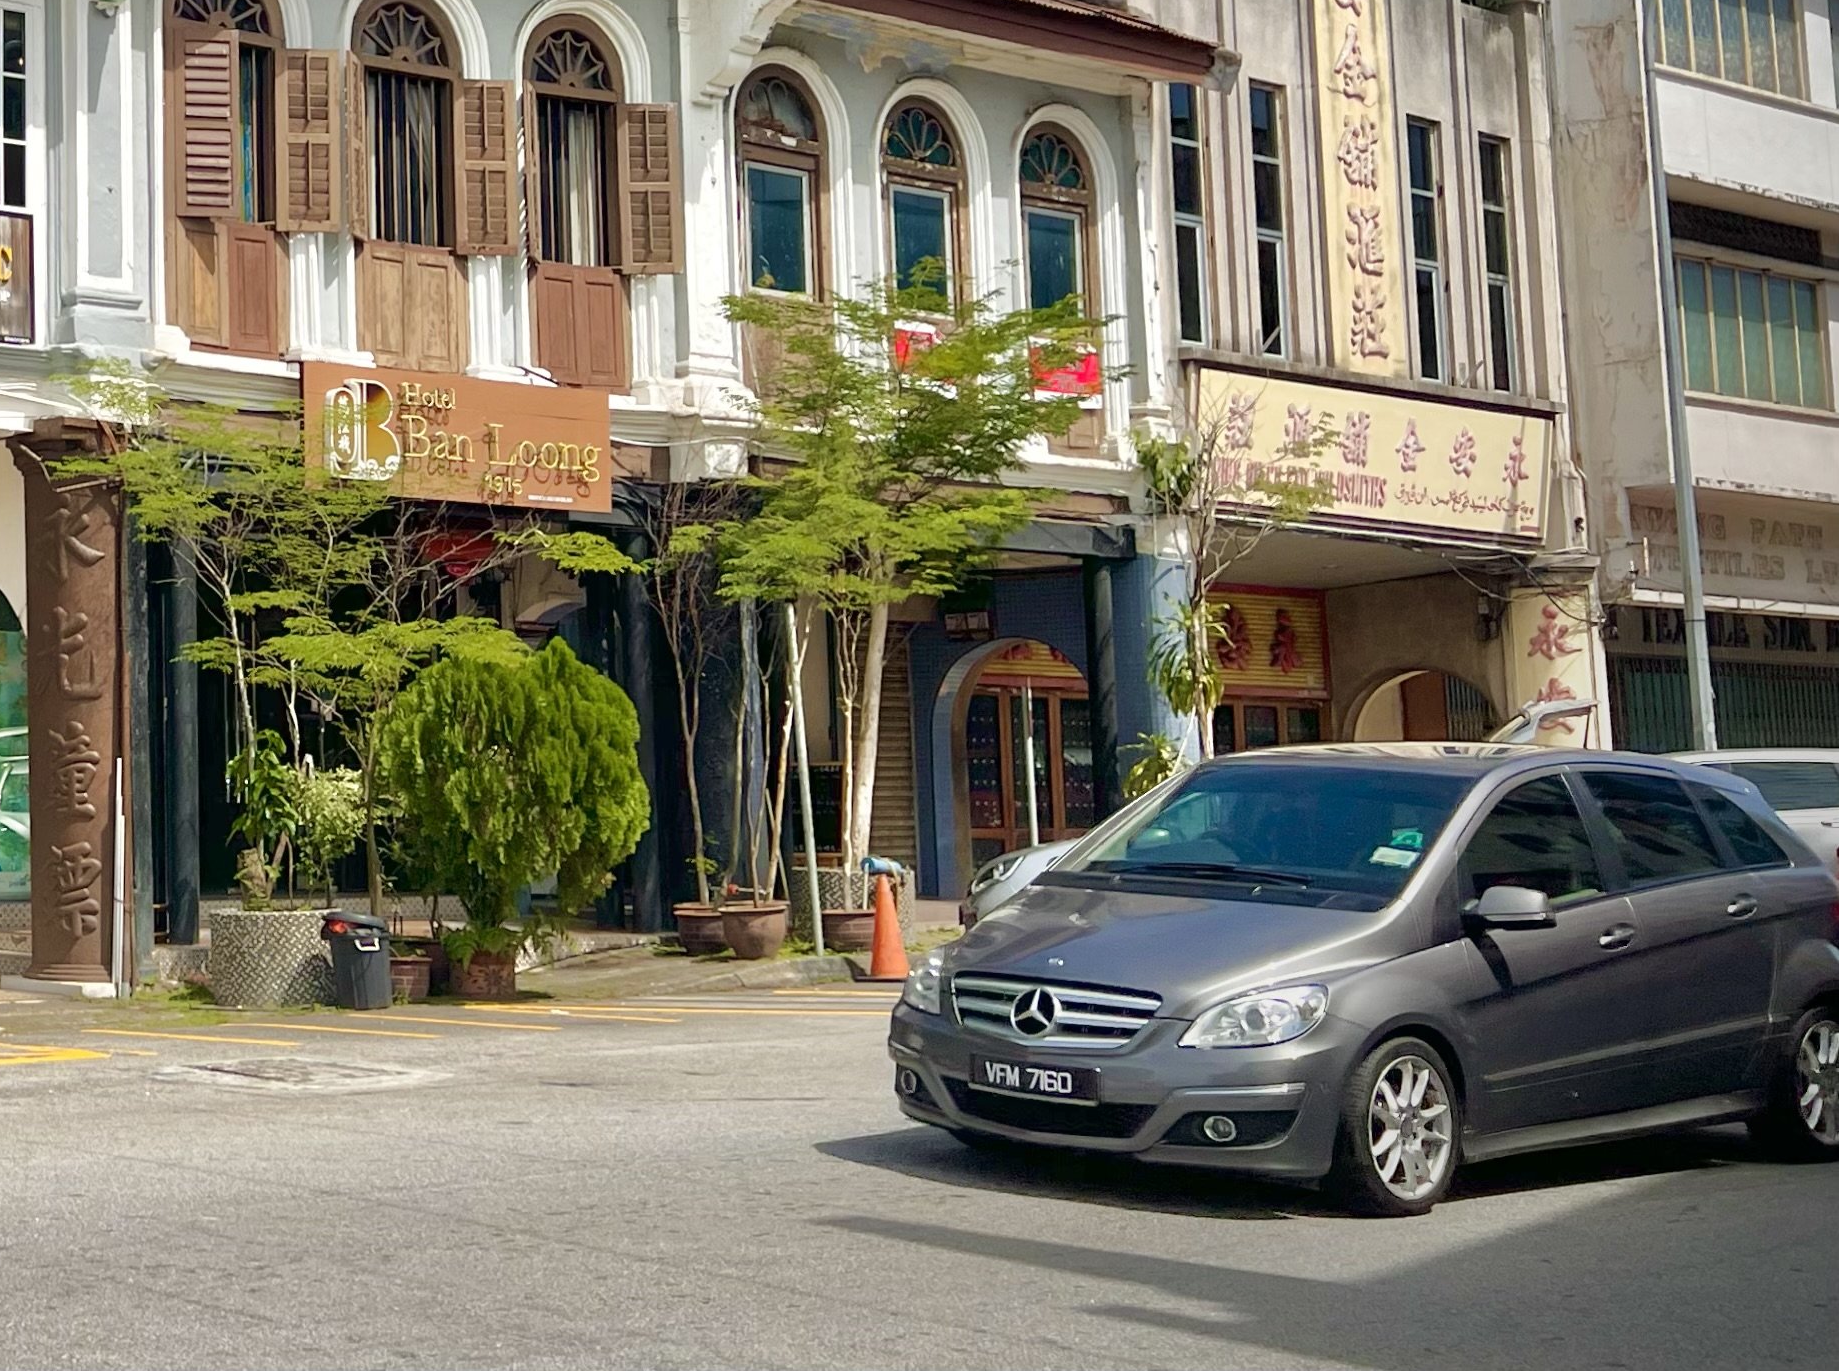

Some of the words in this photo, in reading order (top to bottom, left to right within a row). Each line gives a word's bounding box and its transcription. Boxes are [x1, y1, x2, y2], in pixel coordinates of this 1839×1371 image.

[401, 382, 456, 410] Hotel
[402, 415, 476, 463] Ban
[488, 423, 602, 482] Loong
[1647, 543, 1786, 581] TETILES
[985, 1061, 1020, 1087] VFM
[1025, 1068, 1073, 1094] 7160
